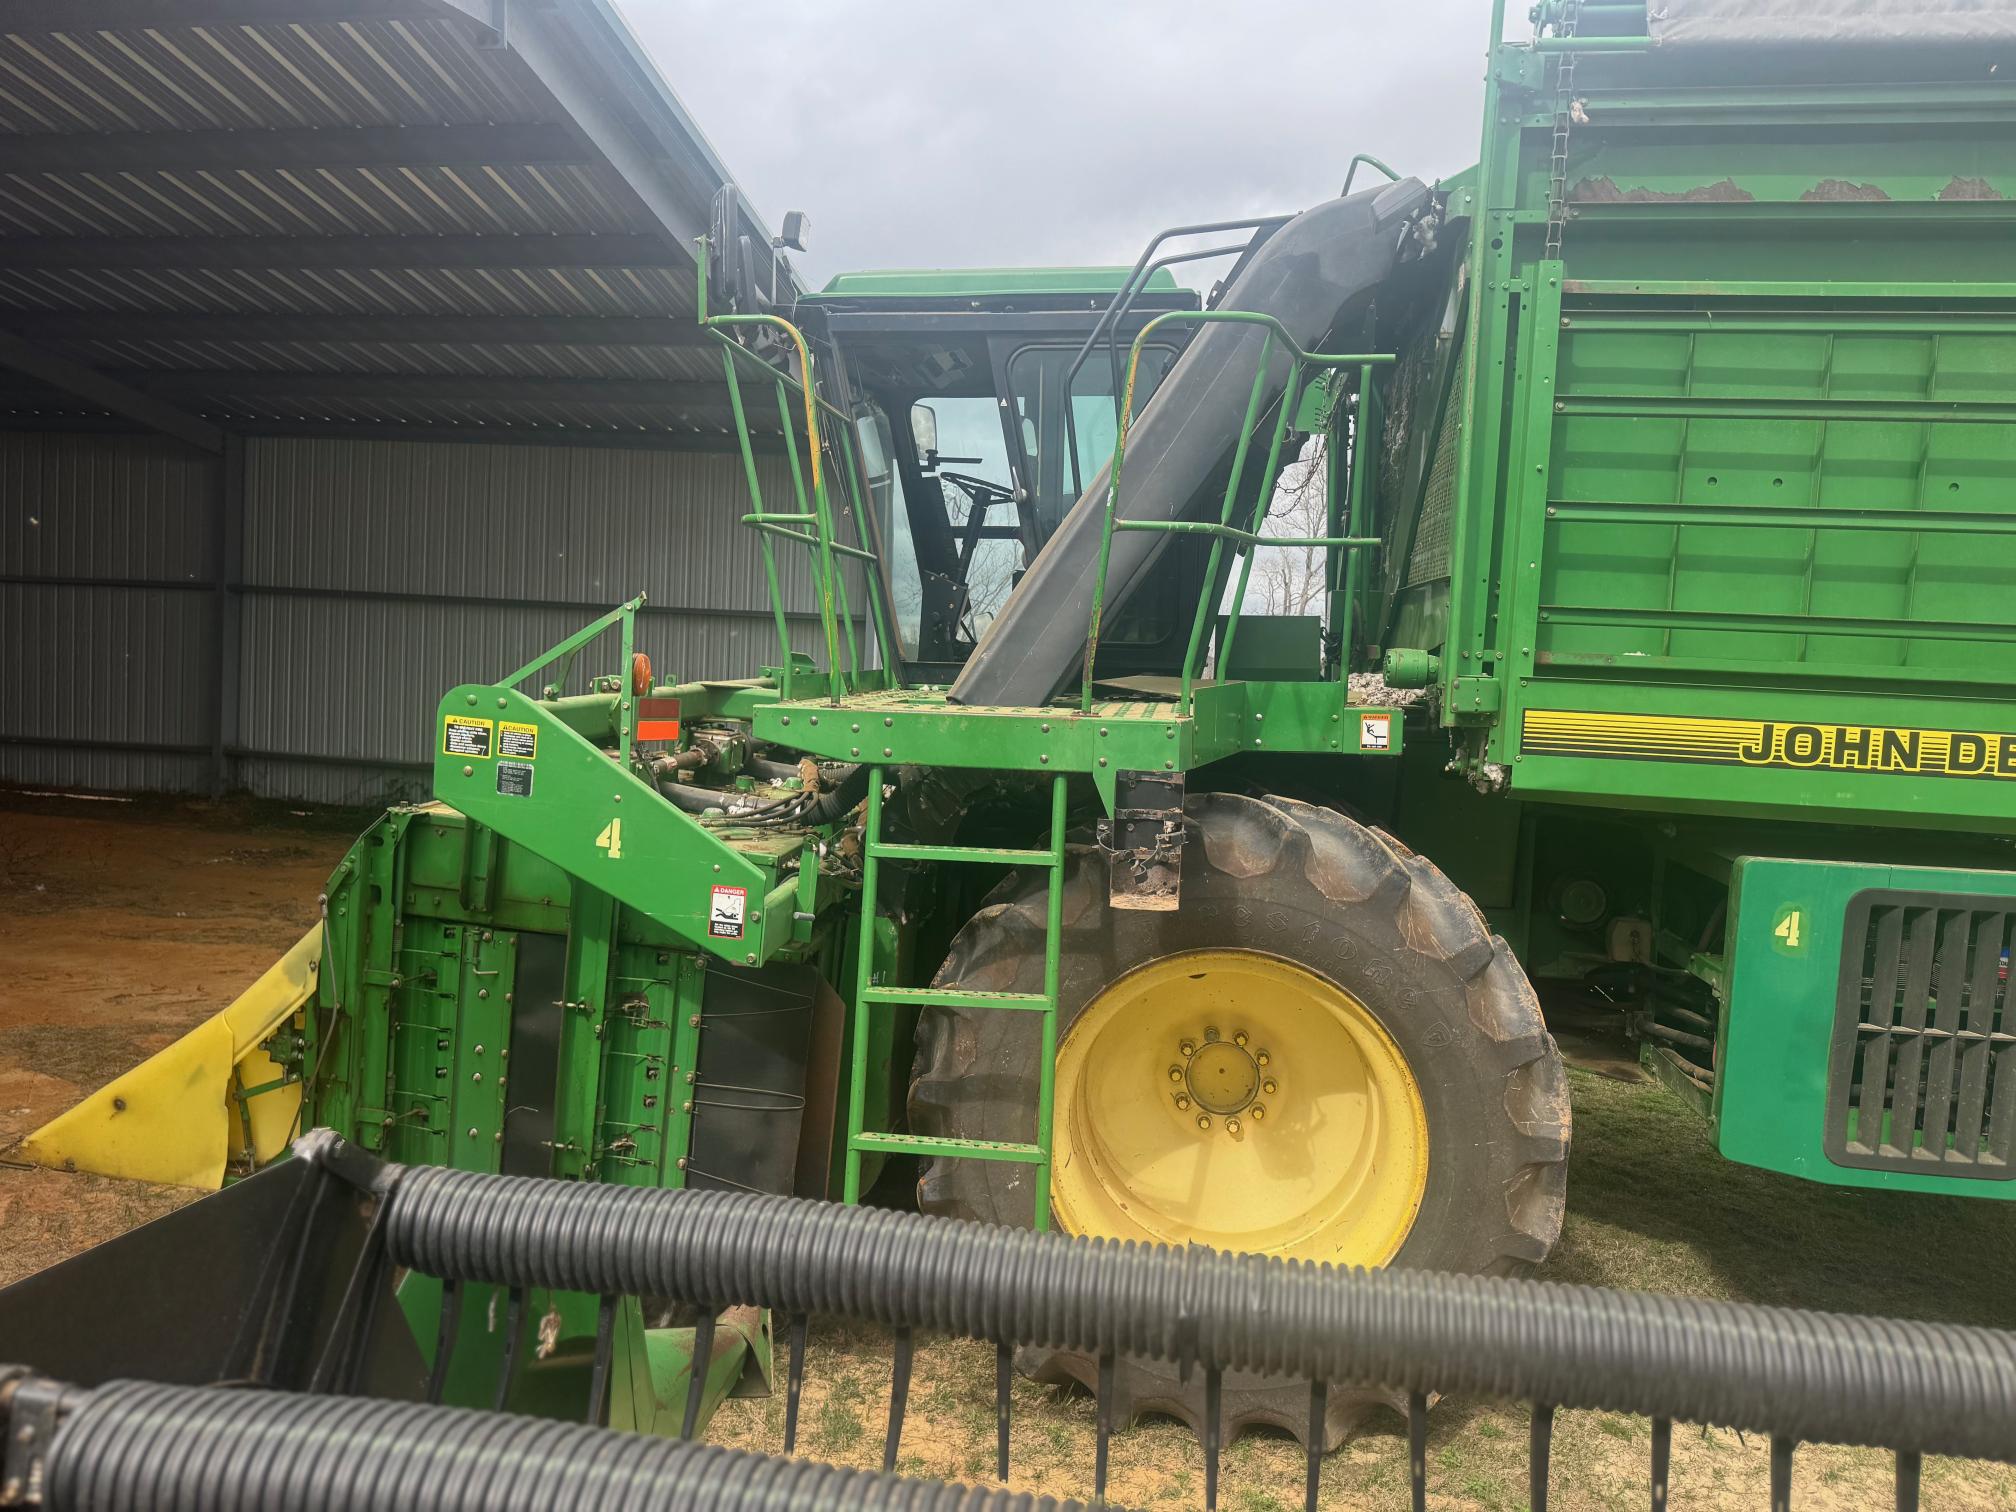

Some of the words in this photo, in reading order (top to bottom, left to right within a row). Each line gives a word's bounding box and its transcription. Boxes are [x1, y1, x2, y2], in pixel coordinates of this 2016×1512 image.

[508, 725, 534, 733] CAUTION
[1739, 722, 1921, 772] JOHN
[595, 817, 622, 859] 4
[720, 887, 744, 895] DANGER
[1774, 911, 1800, 946] 4
